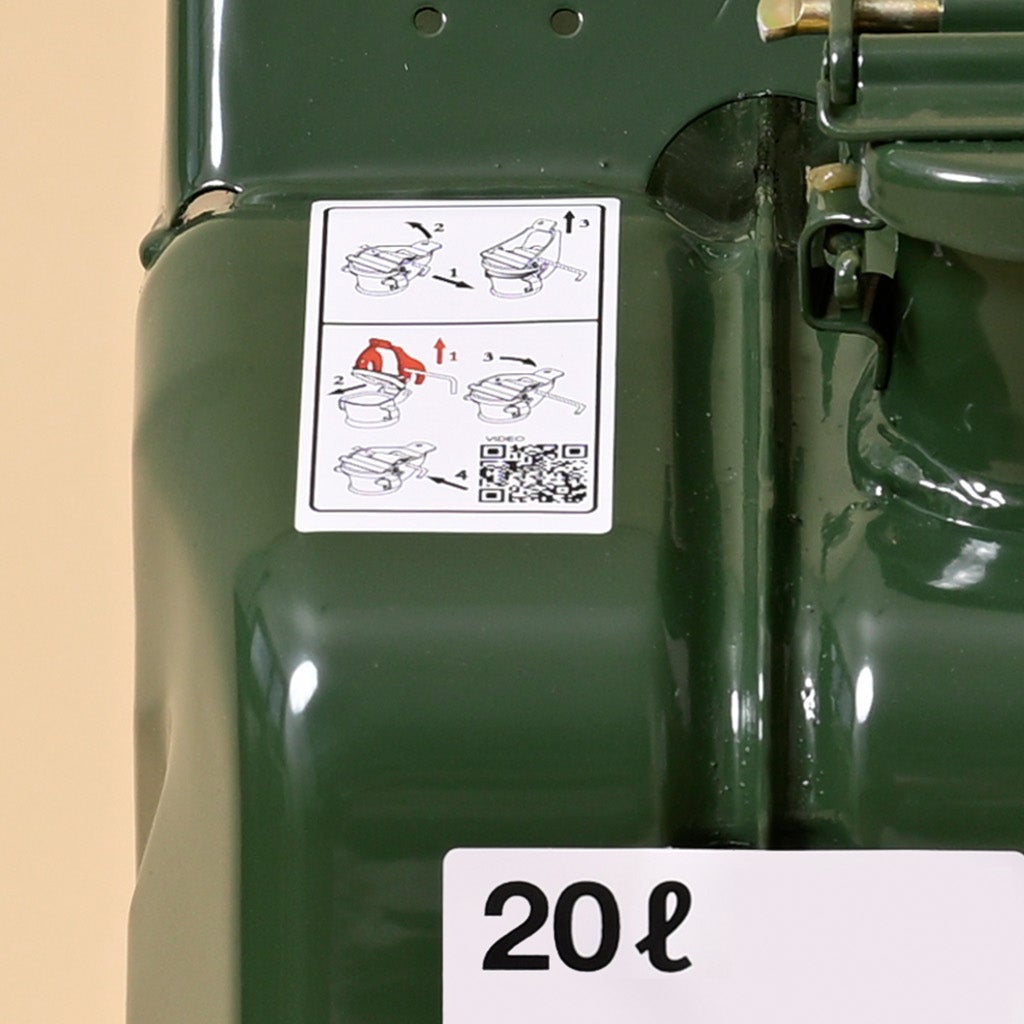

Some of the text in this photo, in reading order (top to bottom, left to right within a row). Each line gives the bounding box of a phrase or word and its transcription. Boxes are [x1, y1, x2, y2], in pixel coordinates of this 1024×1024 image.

[433, 222, 445, 233] 2
[580, 218, 590, 228] 3
[450, 267, 458, 277] 1
[449, 351, 458, 362] 1
[482, 351, 494, 362] 3
[333, 375, 345, 386] 2
[454, 469, 468, 481] 4
